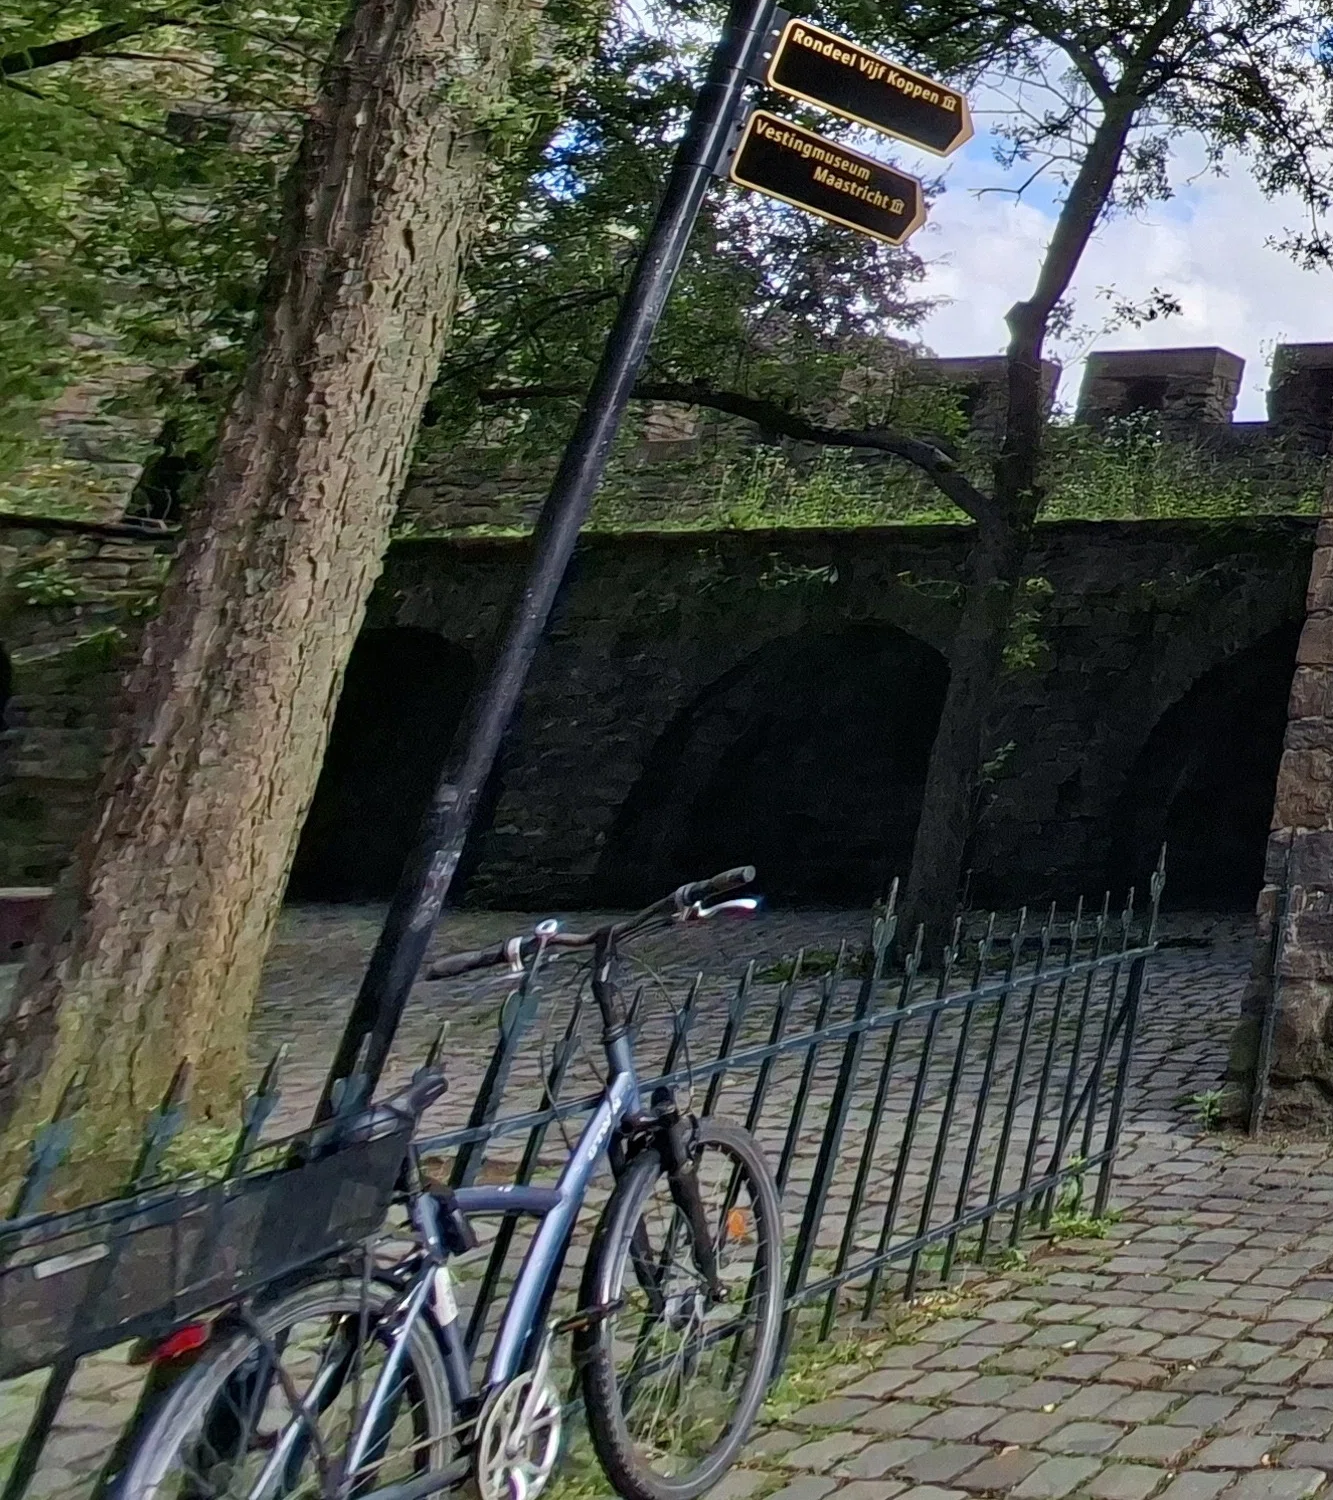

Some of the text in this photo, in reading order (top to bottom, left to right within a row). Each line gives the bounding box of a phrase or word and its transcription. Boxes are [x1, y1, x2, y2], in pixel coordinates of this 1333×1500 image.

[793, 28, 940, 104] Rondeel Vijf Koppen
[755, 119, 871, 181] Vestingmuseum
[813, 166, 890, 210] Maastricht
